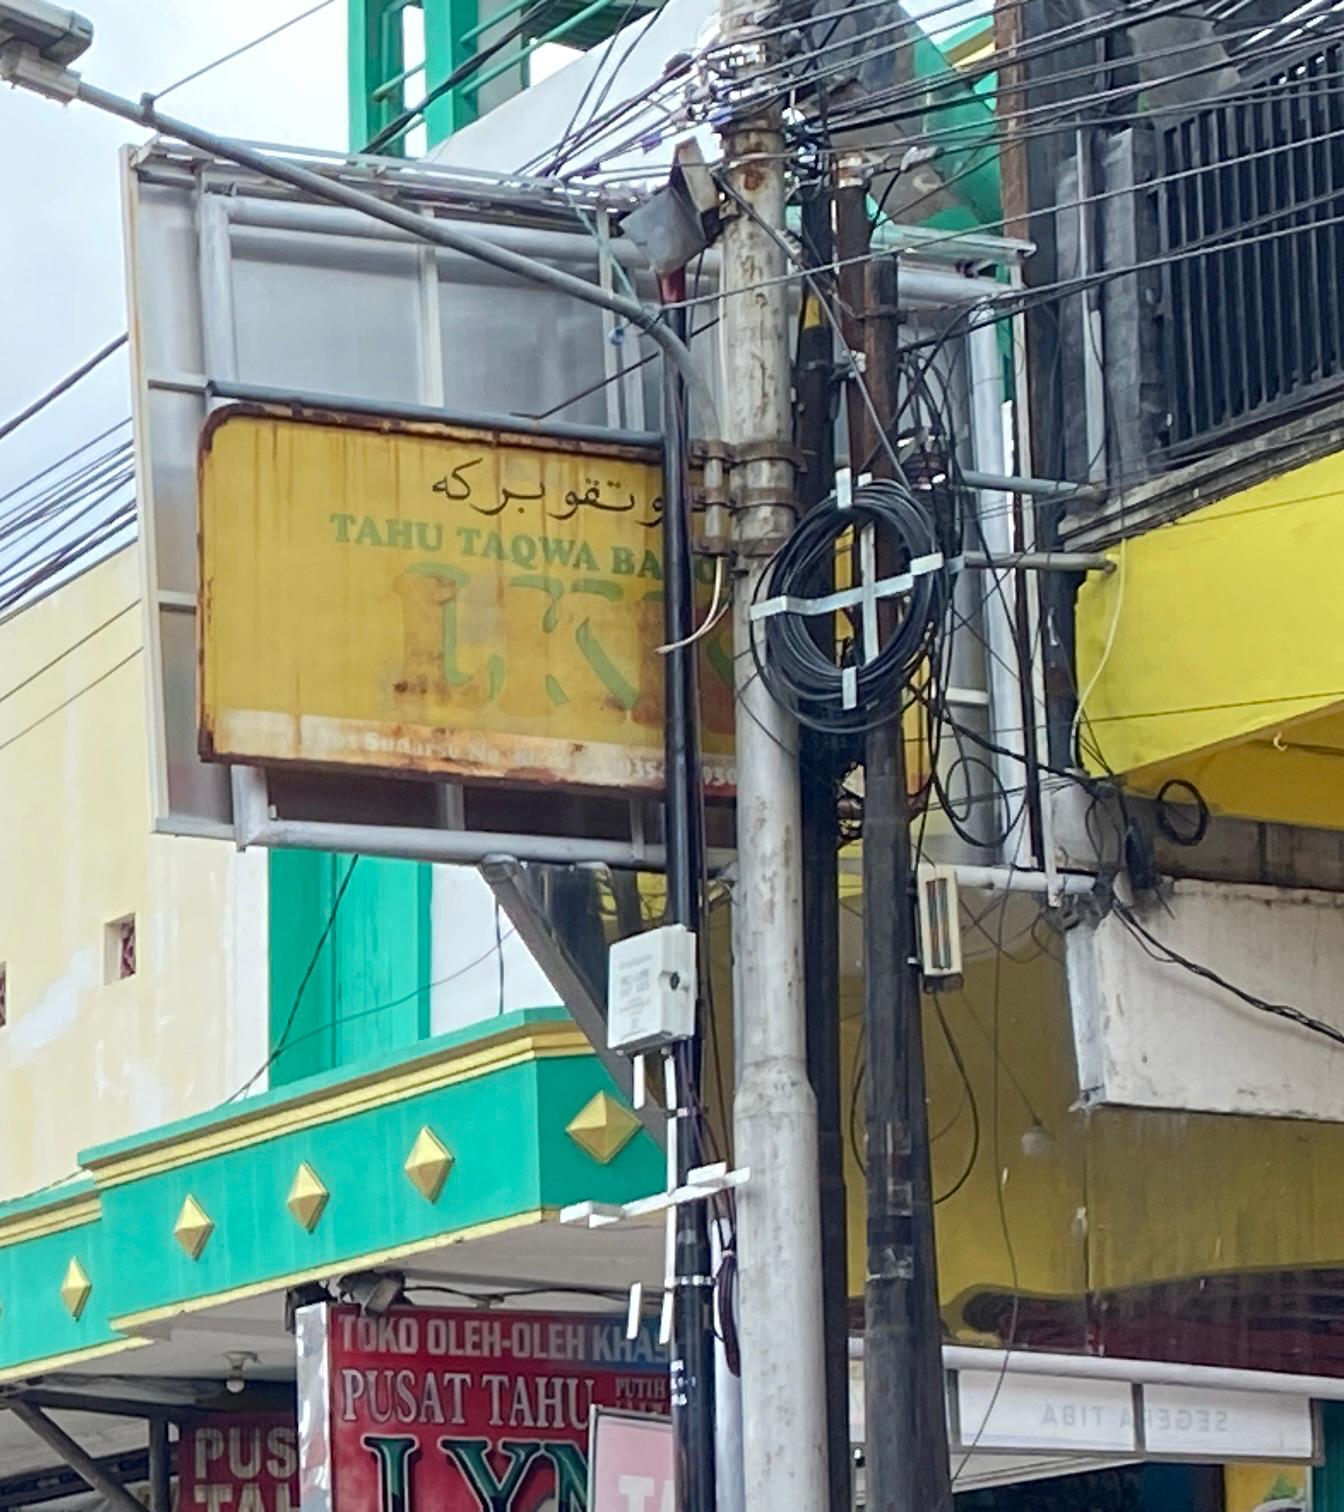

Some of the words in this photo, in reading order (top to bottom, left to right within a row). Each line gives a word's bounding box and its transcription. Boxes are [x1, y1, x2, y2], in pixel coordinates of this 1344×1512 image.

[330, 512, 443, 552] TAHU
[456, 527, 599, 570] TAQWA
[339, 1315, 419, 1354] TOKO
[427, 1319, 585, 1361] OLEH-OLEH
[342, 1370, 471, 1422] PUSAT
[482, 1375, 594, 1428] TAHU
[615, 1377, 666, 1398] PUTIH
[194, 1427, 299, 1479] PUS
